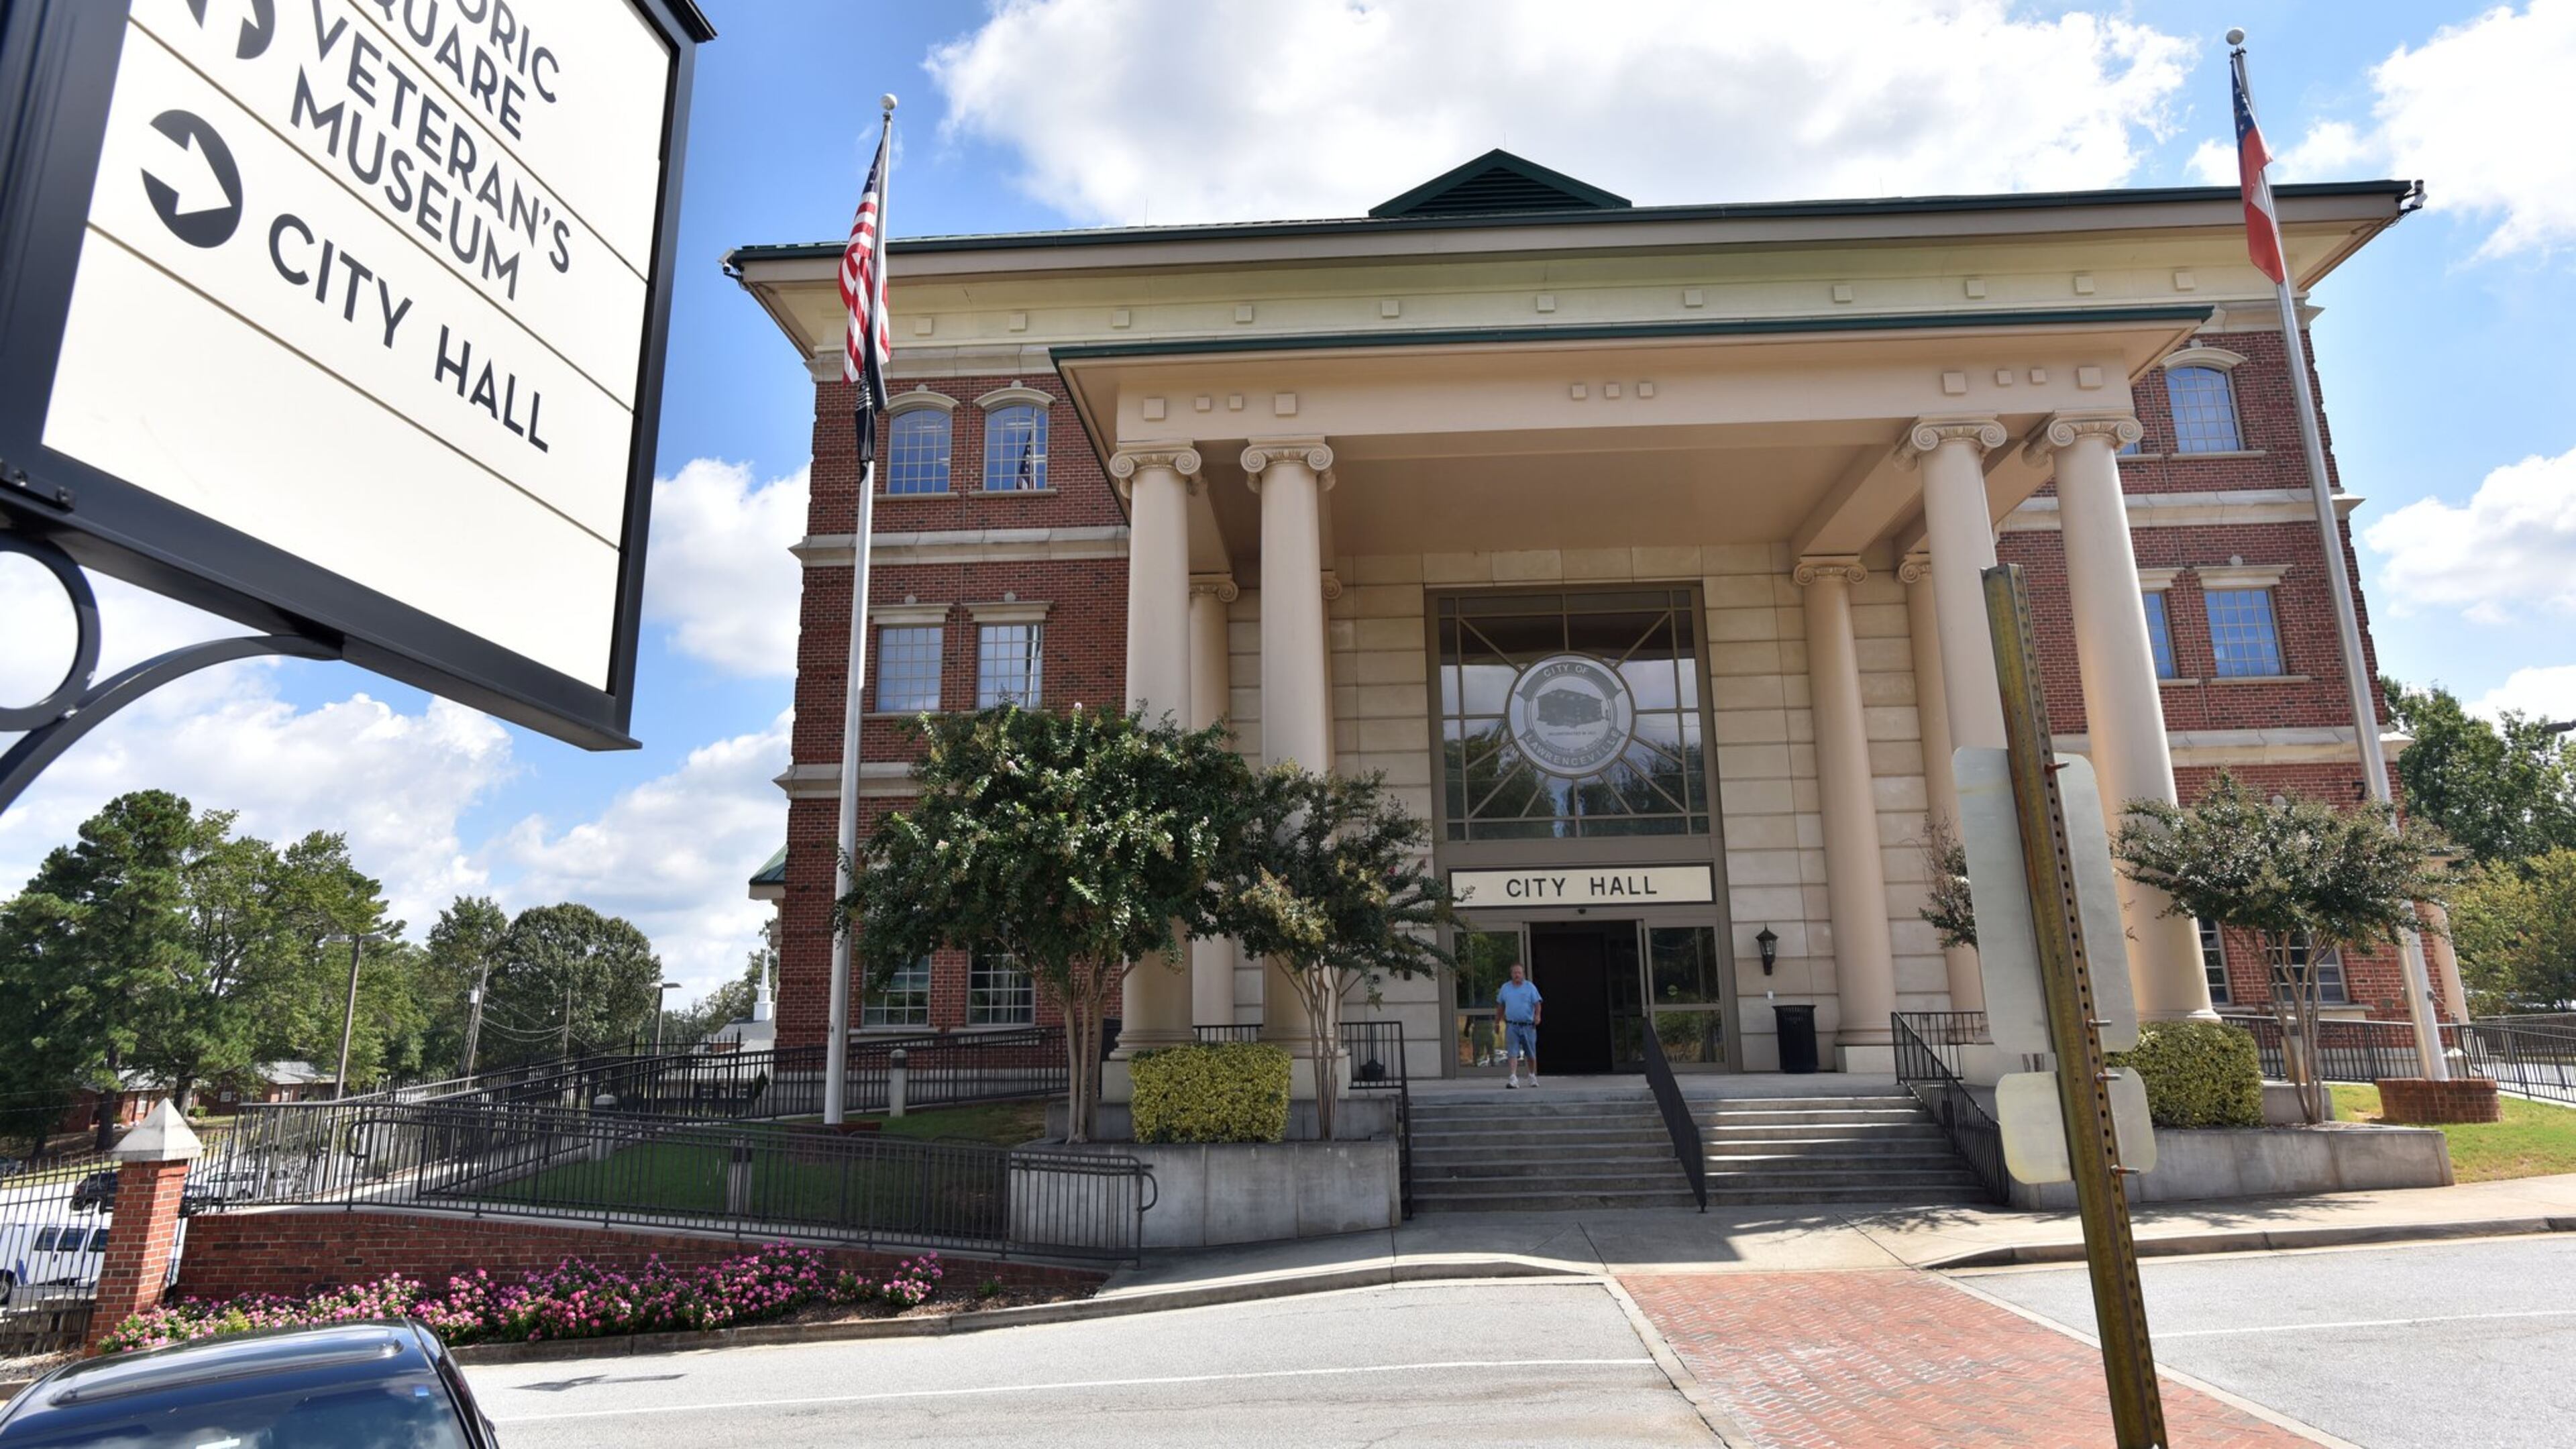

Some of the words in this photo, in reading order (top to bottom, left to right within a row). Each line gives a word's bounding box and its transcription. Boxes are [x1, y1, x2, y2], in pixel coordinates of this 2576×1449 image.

[290, 65, 520, 301] MUSEUM
[311, 0, 570, 274] VETERAN'S
[268, 213, 413, 350] CITY
[434, 324, 549, 453] HALL
[1544, 663, 1569, 678] CITY
[1575, 665, 1589, 675] OF
[1525, 729, 1620, 765] LAWRENCEVILLE
[1506, 877, 1566, 898] CITY
[1590, 875, 1658, 896] HALL
